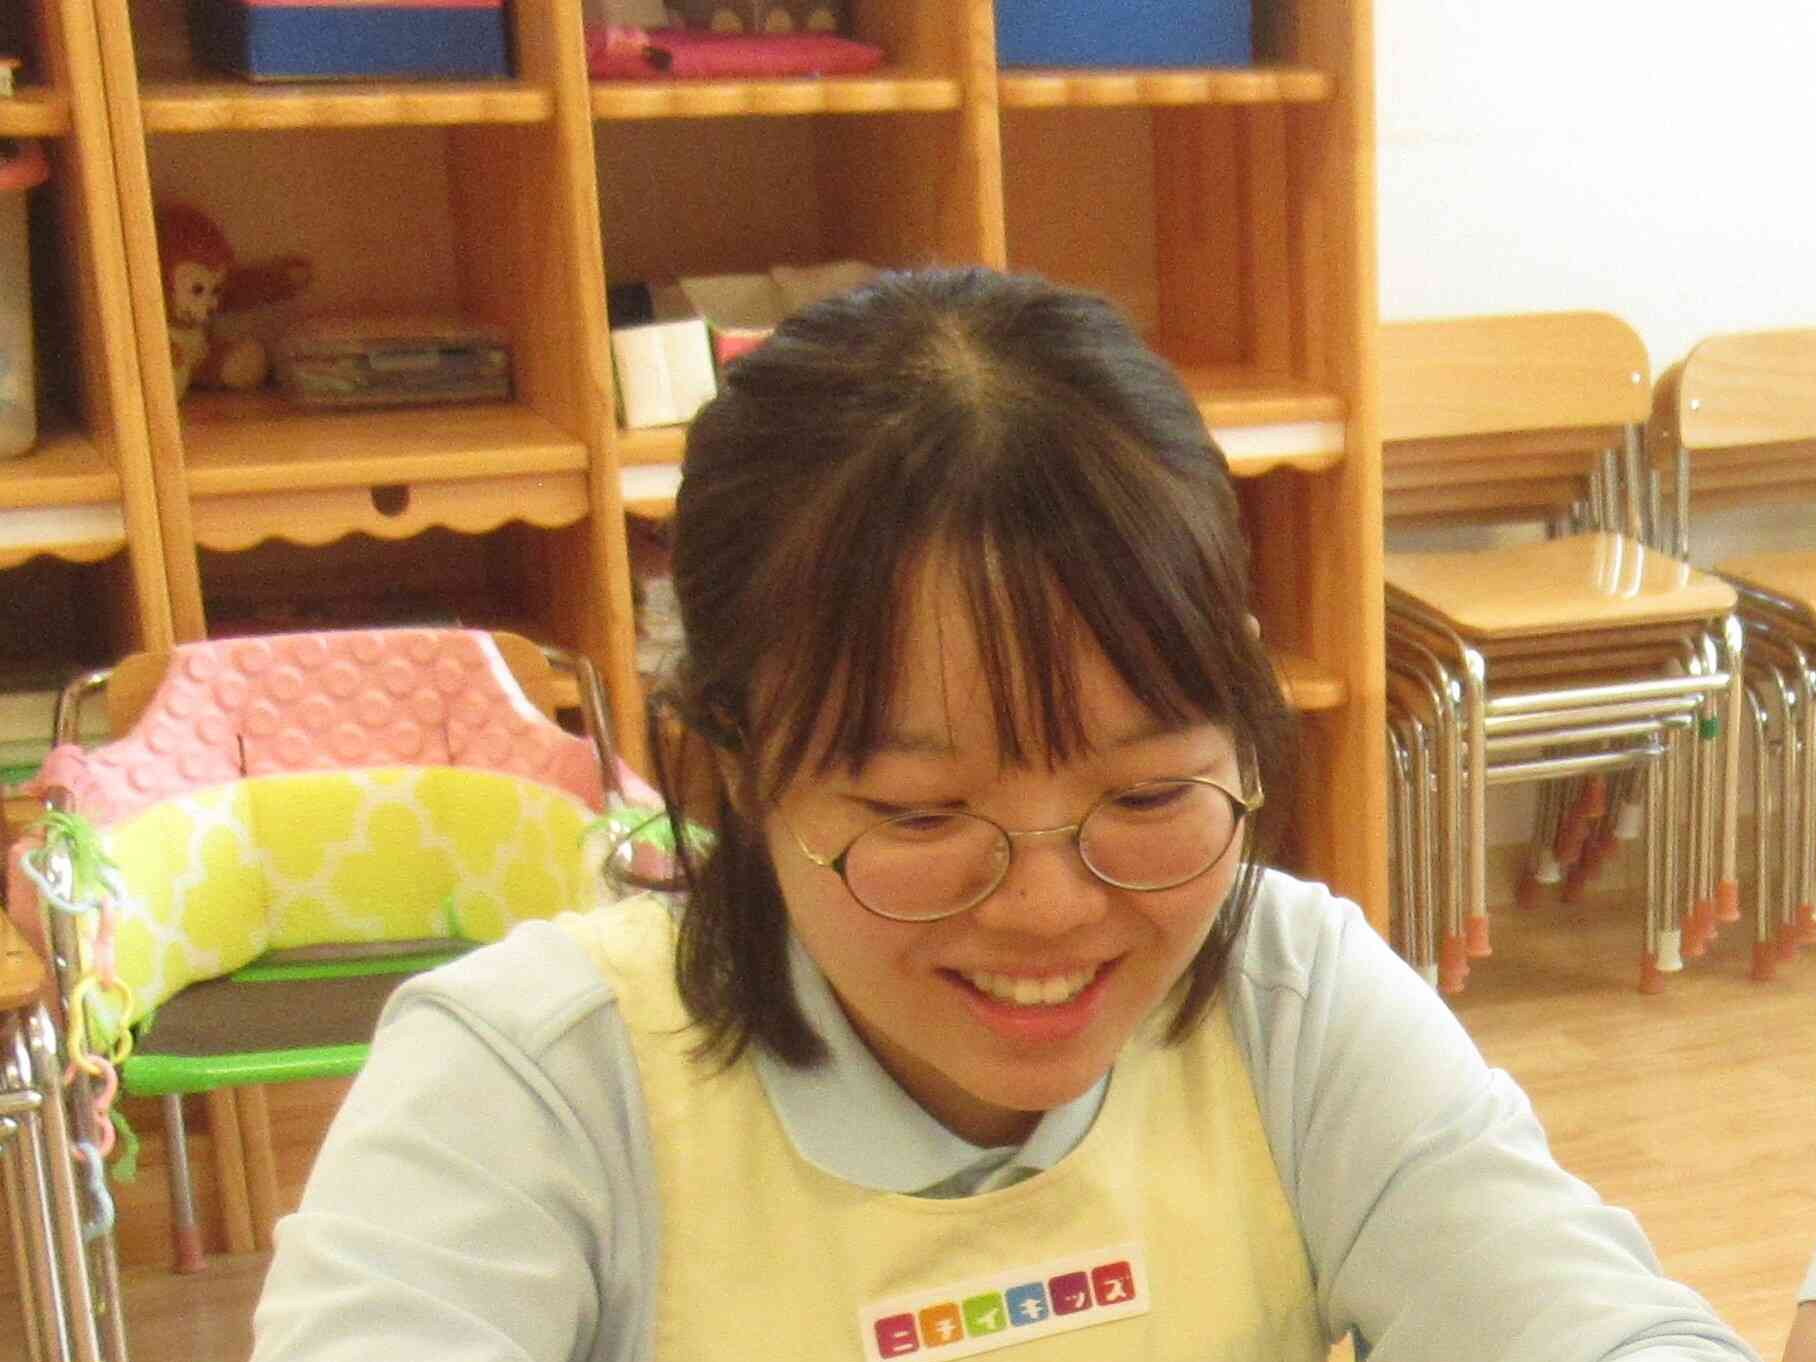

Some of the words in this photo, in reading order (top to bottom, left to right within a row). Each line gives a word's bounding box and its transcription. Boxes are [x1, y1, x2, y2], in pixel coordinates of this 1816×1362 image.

[891, 1274, 1133, 1353] ニチイキッズ
